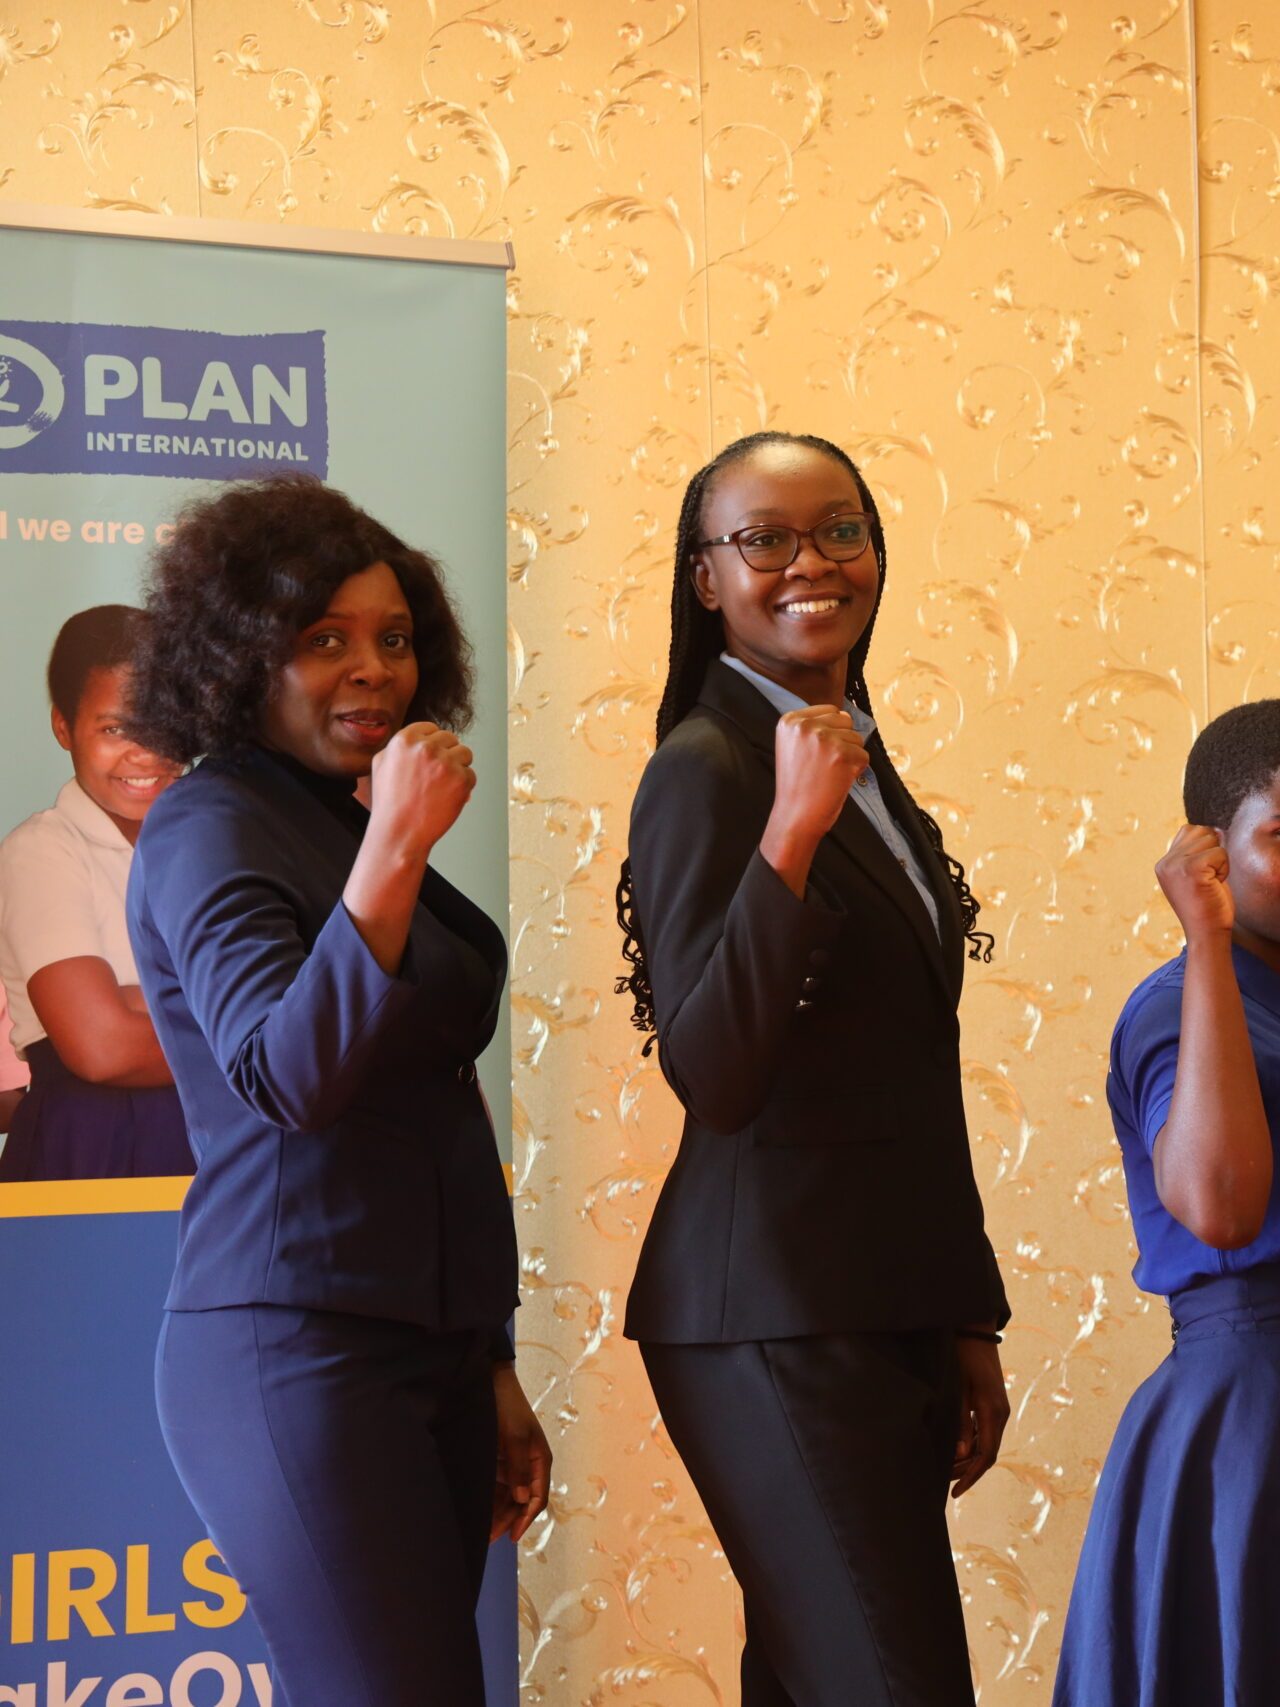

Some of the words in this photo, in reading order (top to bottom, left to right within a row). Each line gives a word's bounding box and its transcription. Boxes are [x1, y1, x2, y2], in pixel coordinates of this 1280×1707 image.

[84, 353, 308, 427] PLAN
[86, 431, 309, 462] INTERNATIONAL
[18, 518, 71, 542] we
[81, 520, 145, 544] are
[0, 1538, 247, 1644] IRLS
